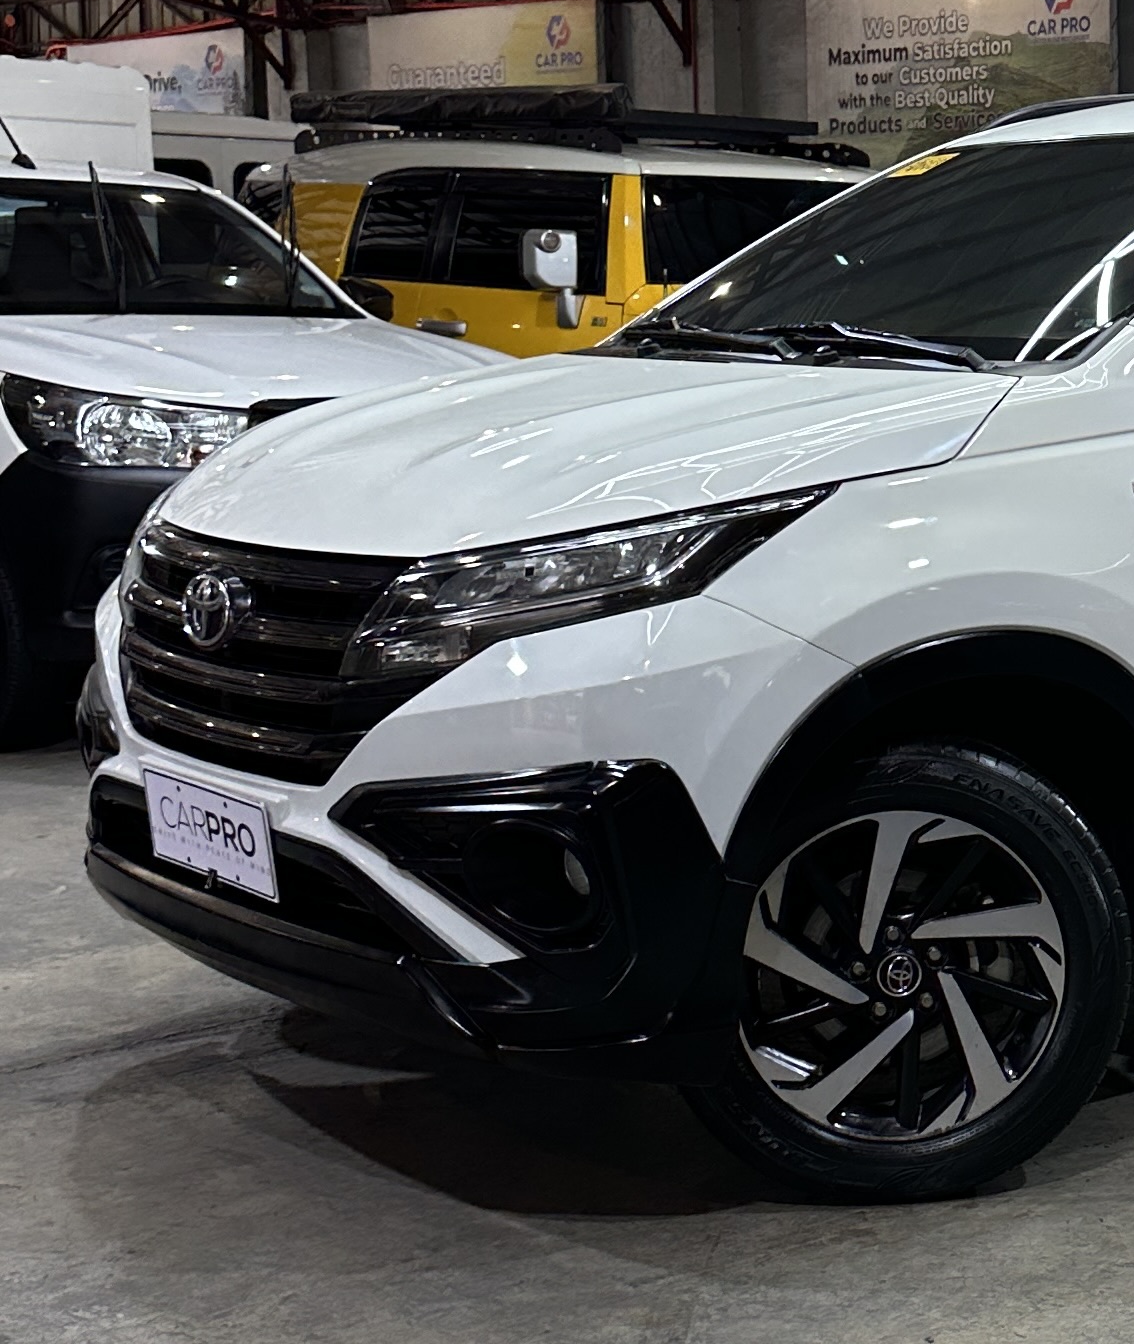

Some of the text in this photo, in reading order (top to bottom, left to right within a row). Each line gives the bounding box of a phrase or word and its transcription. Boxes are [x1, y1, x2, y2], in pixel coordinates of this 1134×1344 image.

[863, 8, 970, 40] We Provide
[1027, 16, 1091, 36] CAR PRO
[828, 35, 1012, 66] Maximum Satisfaction
[388, 56, 505, 89] Guaranteed
[856, 64, 988, 86] to our Customers
[838, 84, 995, 110] with the Best Quality
[829, 116, 902, 135] Products
[908, 117, 927, 129] and
[160, 796, 256, 857] CARPRO
